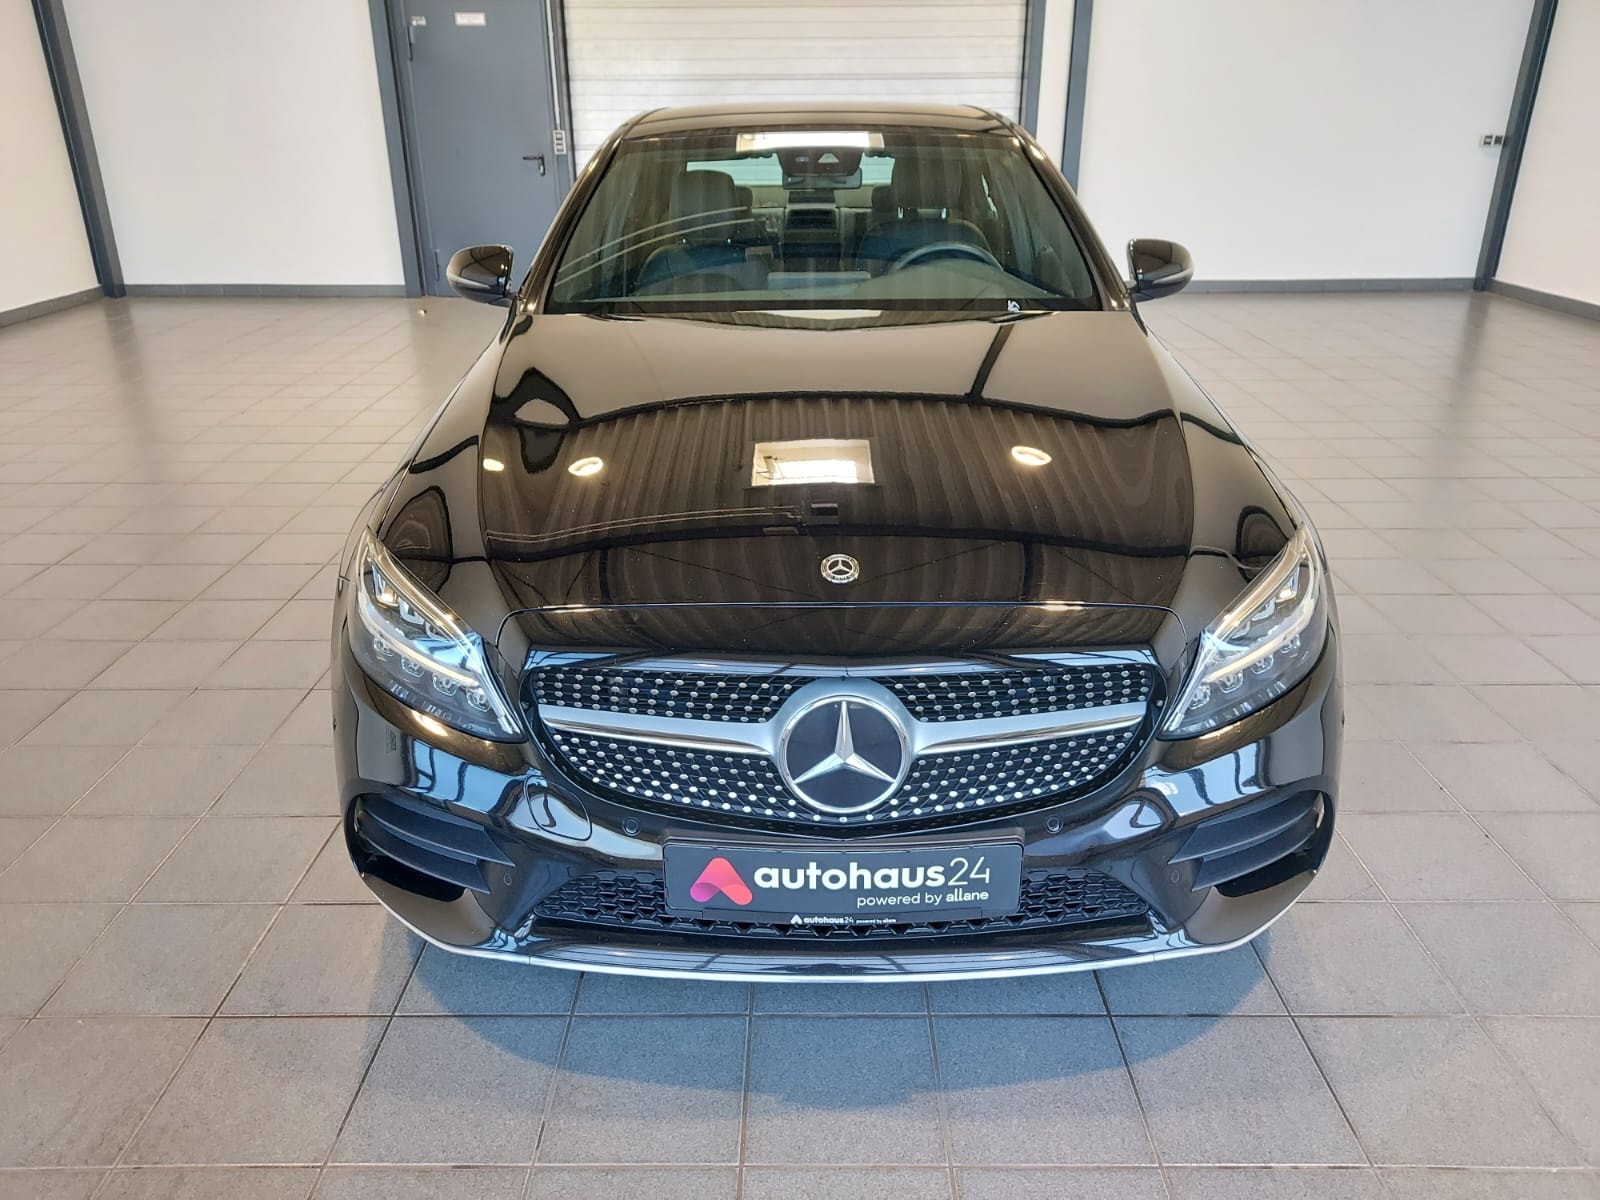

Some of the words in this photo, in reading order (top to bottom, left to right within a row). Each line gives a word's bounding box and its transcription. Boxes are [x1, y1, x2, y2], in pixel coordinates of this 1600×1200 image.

[753, 856, 990, 891] autohaus24
[857, 893, 921, 908] powered
[924, 892, 943, 907] by
[946, 889, 989, 903] allane
[803, 916, 854, 924] autohaus24
